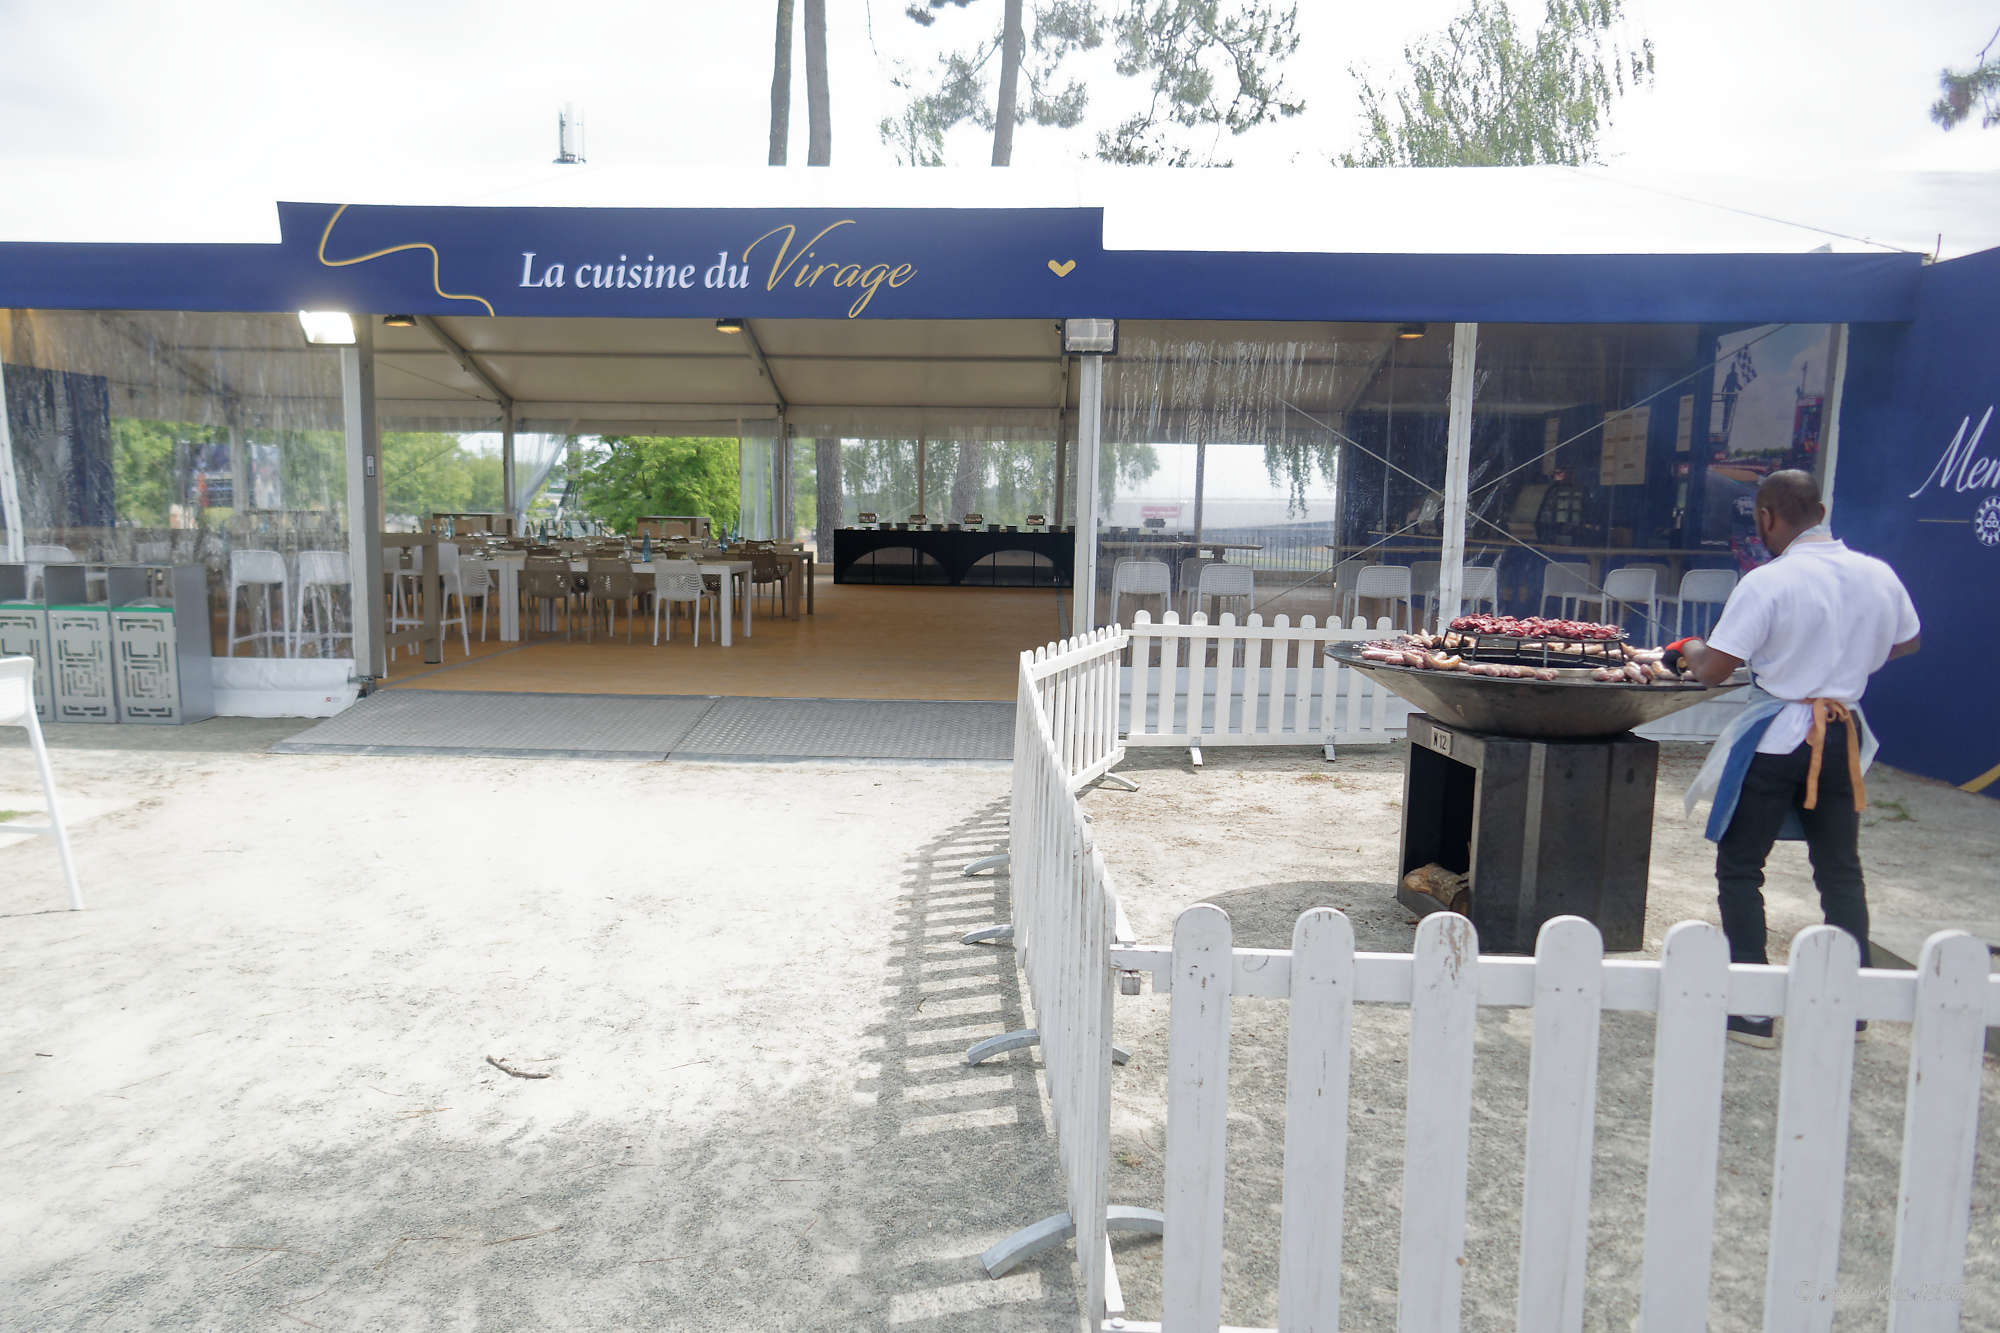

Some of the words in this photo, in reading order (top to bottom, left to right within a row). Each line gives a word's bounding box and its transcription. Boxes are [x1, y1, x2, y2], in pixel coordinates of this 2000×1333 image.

[519, 252, 566, 288] La
[574, 253, 696, 289] cuisine
[704, 251, 750, 289] du
[742, 219, 918, 319] Virage
